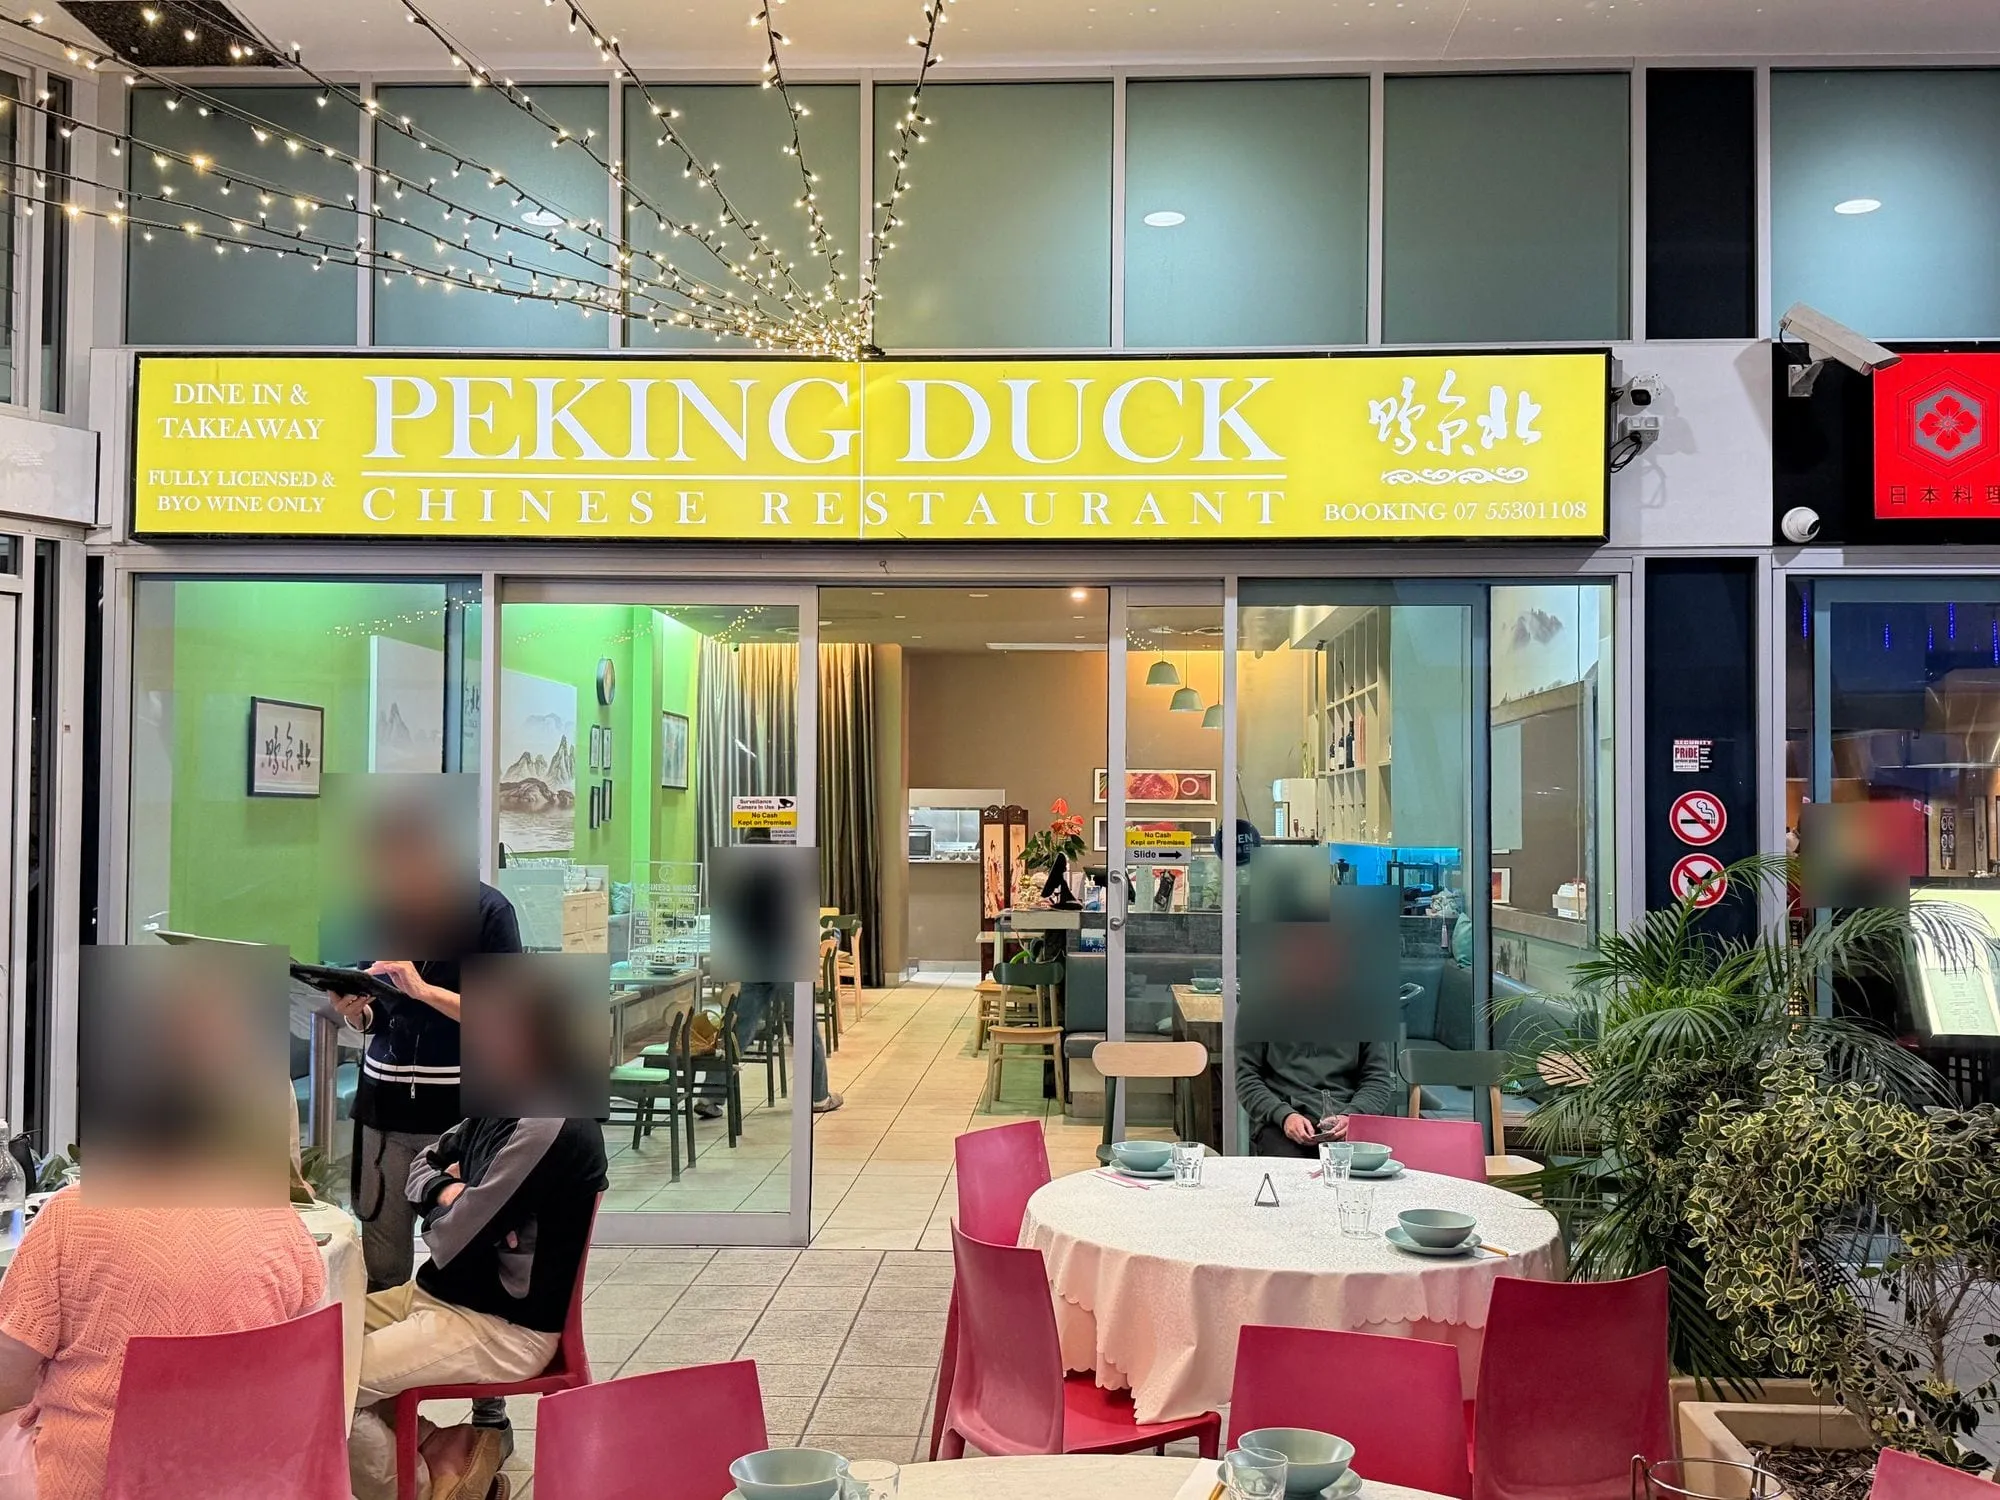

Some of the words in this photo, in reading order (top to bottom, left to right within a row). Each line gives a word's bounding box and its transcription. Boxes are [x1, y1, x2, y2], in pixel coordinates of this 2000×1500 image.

[174, 383, 245, 405] DINE
[252, 383, 282, 405] IN
[289, 383, 309, 406] &
[157, 416, 324, 441] TAKEAWAY
[363, 375, 862, 464] PEKING
[897, 376, 1286, 464] DUCK
[148, 469, 213, 487] FULLY
[217, 470, 315, 488] LICENSED
[321, 471, 337, 488] &
[157, 495, 201, 512] BYO
[205, 496, 262, 512] WINE
[266, 496, 326, 514] ONLY
[1890, 484, 2000, 505] 日本料理
[362, 487, 708, 525] CHINESE
[761, 490, 1286, 526] RESTAURANT
[1324, 502, 1447, 521] BOOKING
[1453, 502, 1479, 520] 07
[1485, 501, 1588, 521] 55301108
[1130, 839, 1146, 847] Kept
[1156, 839, 1186, 847] Premises
[1133, 849, 1157, 859] Slide
